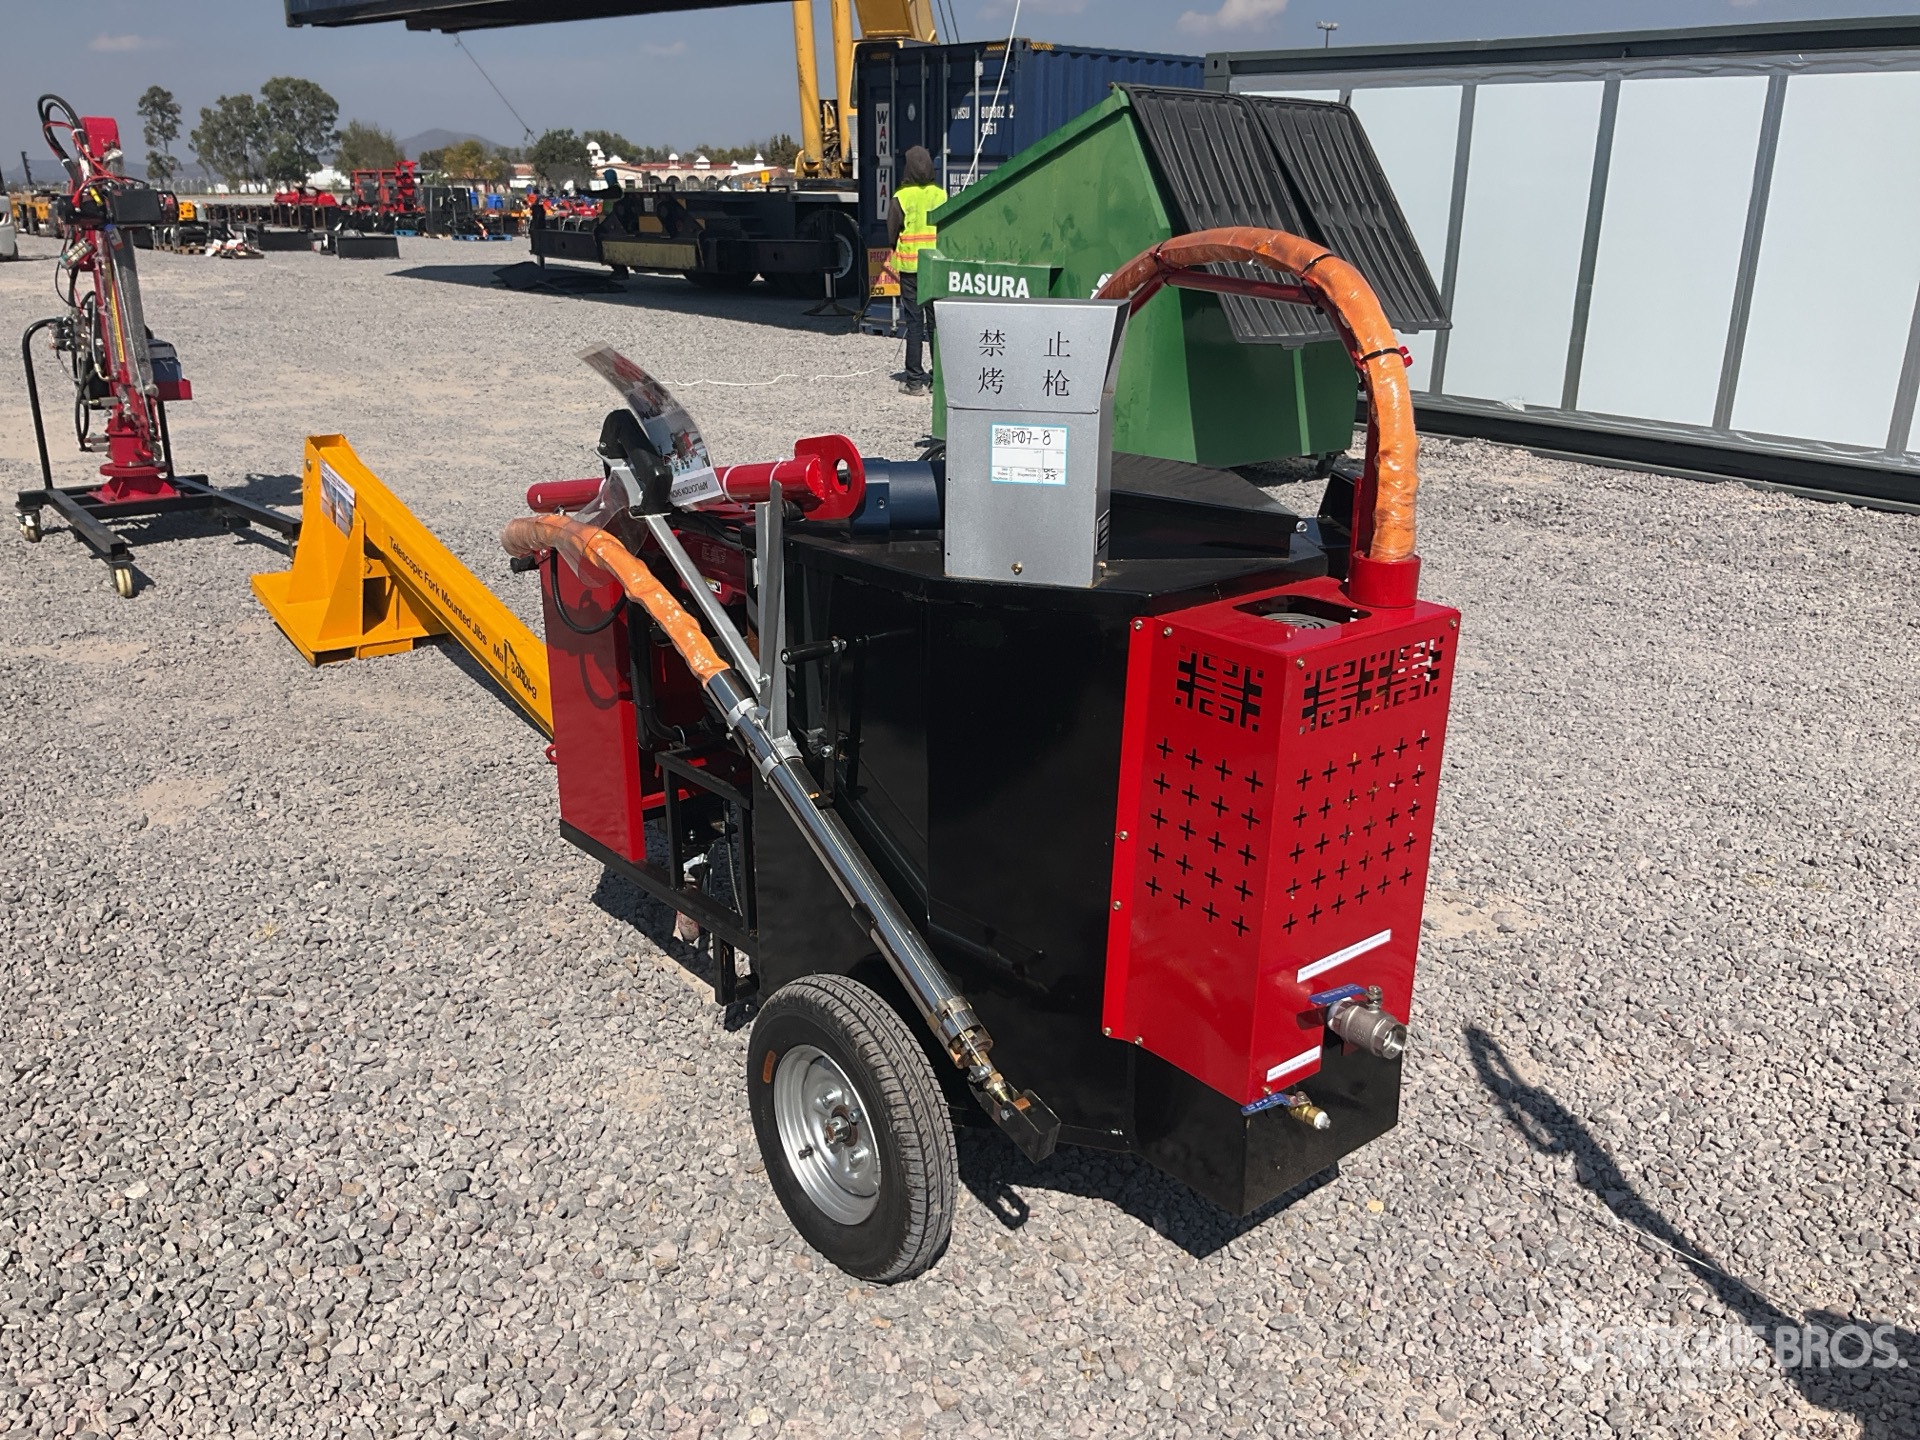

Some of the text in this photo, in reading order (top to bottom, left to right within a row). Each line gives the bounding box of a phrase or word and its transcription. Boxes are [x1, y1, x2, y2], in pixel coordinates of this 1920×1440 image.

[1009, 104, 1014, 118] 2
[877, 111, 888, 212] WAN HAI
[948, 271, 1030, 298] BASURA
[389, 536, 487, 645] Telescopic Fork Mounted Jibs
